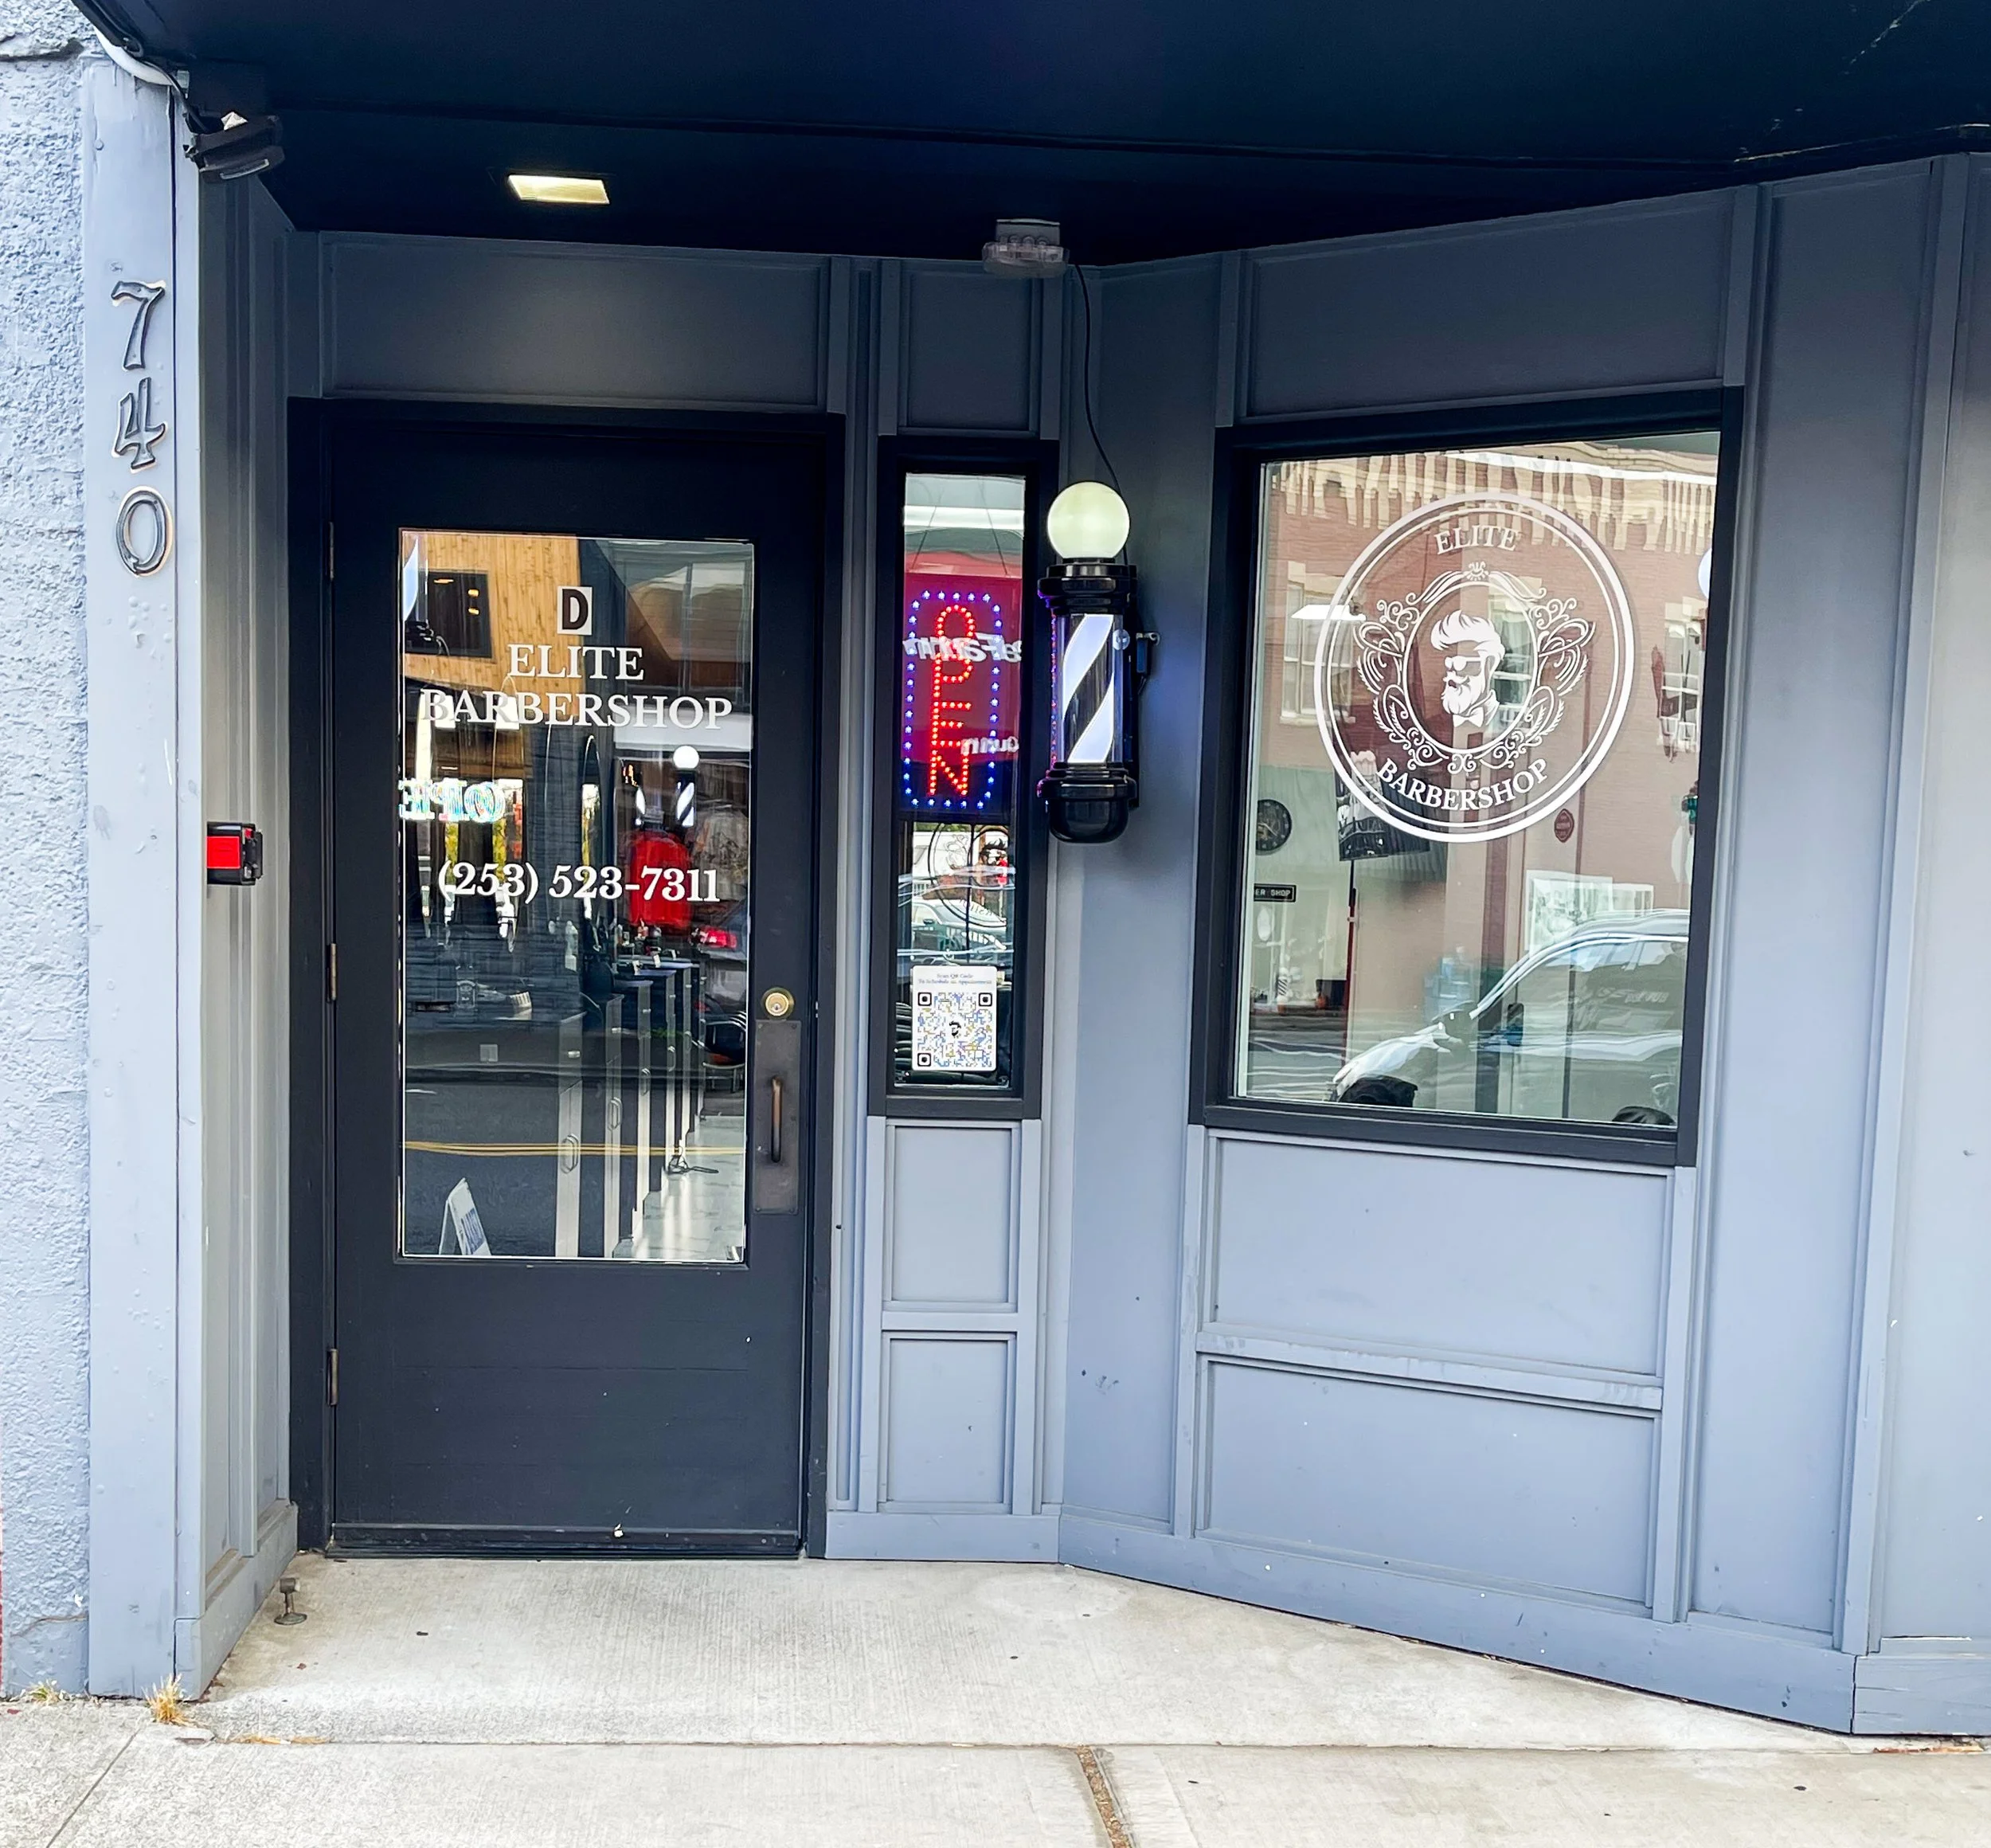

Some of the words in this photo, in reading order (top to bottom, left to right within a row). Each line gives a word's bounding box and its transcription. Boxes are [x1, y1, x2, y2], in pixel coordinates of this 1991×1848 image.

[111, 280, 173, 578] 740
[1434, 525, 1520, 555] ELITE
[561, 588, 589, 630] D
[507, 644, 645, 681] ELITE
[420, 687, 733, 730] BARBERSHOP
[926, 602, 976, 797] OPEN
[1376, 758, 1548, 811] BARBERSHOP
[438, 859, 539, 904] (253)
[549, 865, 721, 902] 523-7311
